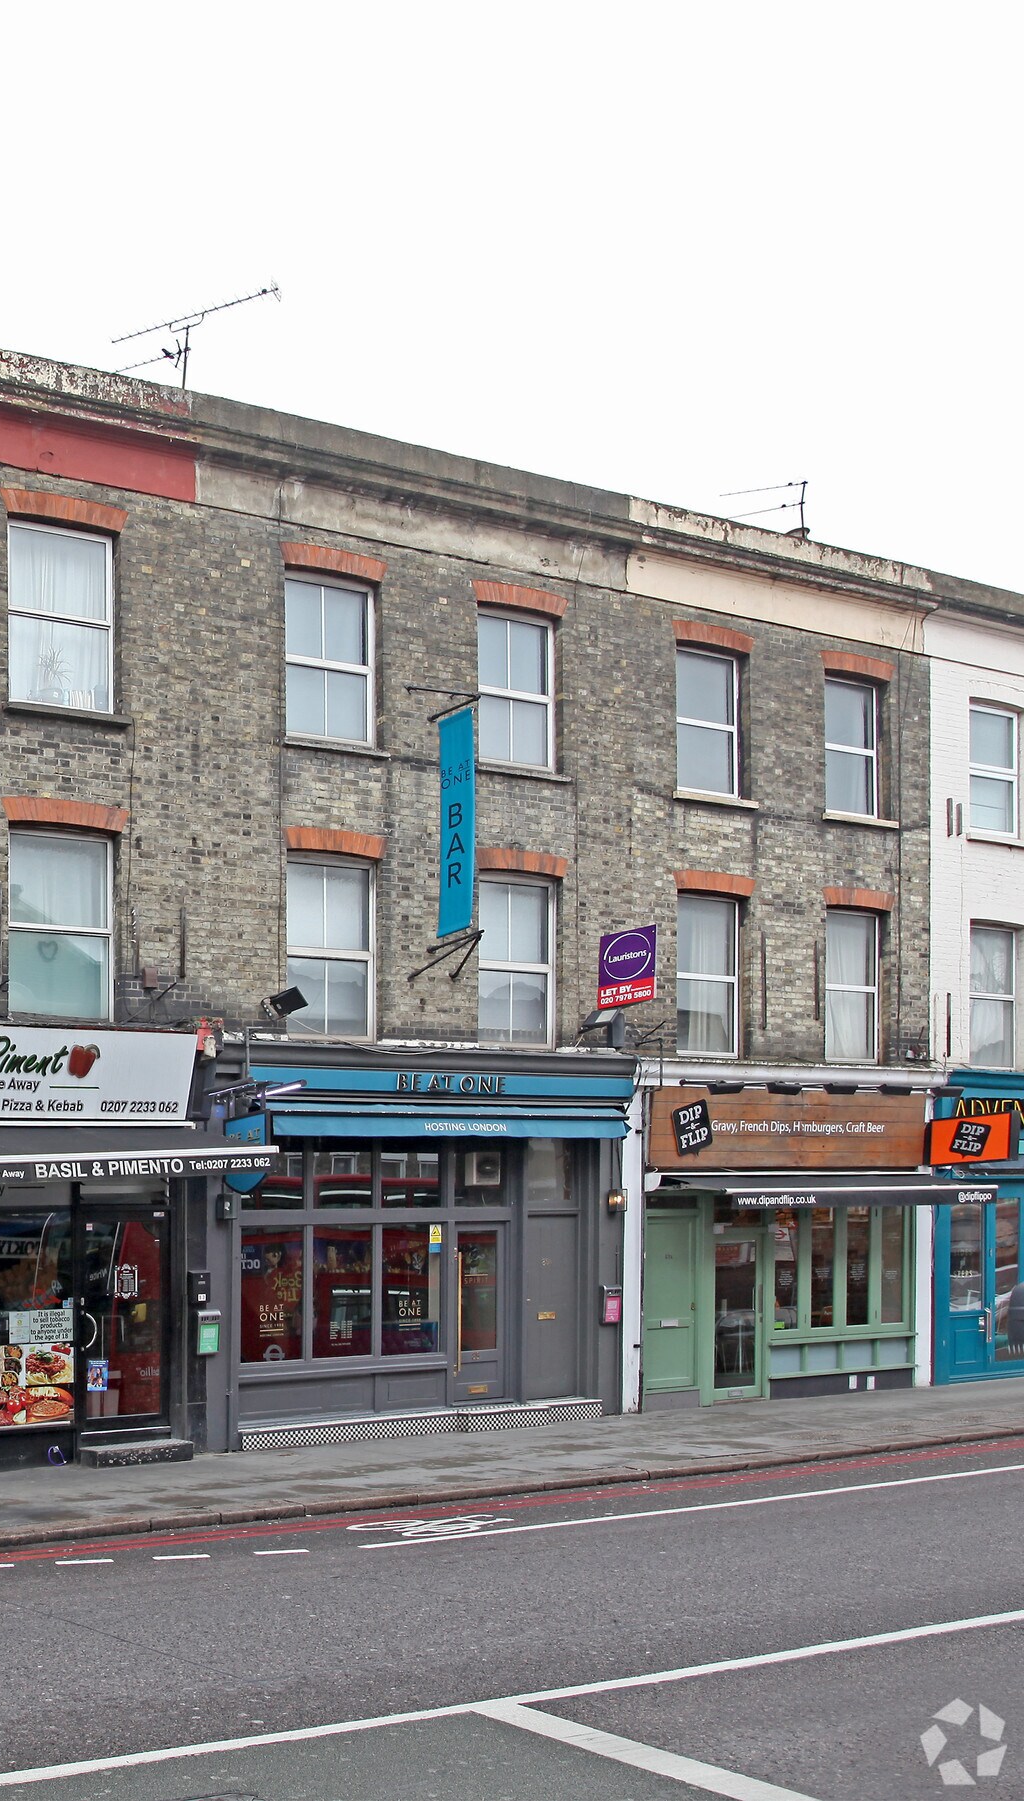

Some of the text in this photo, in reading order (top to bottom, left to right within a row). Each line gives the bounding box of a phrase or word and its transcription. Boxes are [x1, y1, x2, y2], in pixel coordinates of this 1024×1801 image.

[441, 760, 471, 779] BE AT
[441, 770, 471, 790] ONE
[446, 802, 465, 889] BAR
[608, 949, 647, 964] Lauristons
[600, 987, 618, 997] LET
[600, 989, 652, 1005] 020 7978 5800
[10, 1079, 41, 1093] Away
[396, 1073, 506, 1094] BE AT ONE
[2, 1099, 33, 1112] Pizza
[35, 1100, 45, 1112] &
[48, 1100, 84, 1112] Kebab
[100, 1101, 179, 1114] 0207 2233 062
[678, 1105, 702, 1125] DIP
[424, 1122, 507, 1132] HOSTING LONDON
[711, 1119, 738, 1134] Gravy,
[740, 1120, 769, 1132] French
[770, 1120, 791, 1134] Dips,
[845, 1121, 865, 1133] Craft
[867, 1121, 885, 1133] Beer
[960, 1123, 985, 1136] DIP
[680, 1127, 708, 1149] FLIP
[953, 1139, 982, 1152] FLIP
[2, 1169, 25, 1180] Away
[35, 1162, 87, 1179] BASIL
[92, 1161, 105, 1177] &
[108, 1158, 184, 1176] PIMENTO
[189, 1159, 228, 1171] Tel:0207
[230, 1158, 252, 1169] 2233
[254, 1157, 271, 1168] 062
[737, 1194, 817, 1206] www.dipandflip.co.uk
[259, 1304, 269, 1312] BE
[399, 1300, 408, 1308] BE
[50, 1310, 65, 1318] illegal
[259, 1312, 284, 1321] ONE
[398, 1307, 422, 1317] ONE
[50, 1315, 71, 1323] tobacco
[40, 1322, 63, 1330] products
[37, 1329, 56, 1337] anyone
[45, 1334, 55, 1342] age
